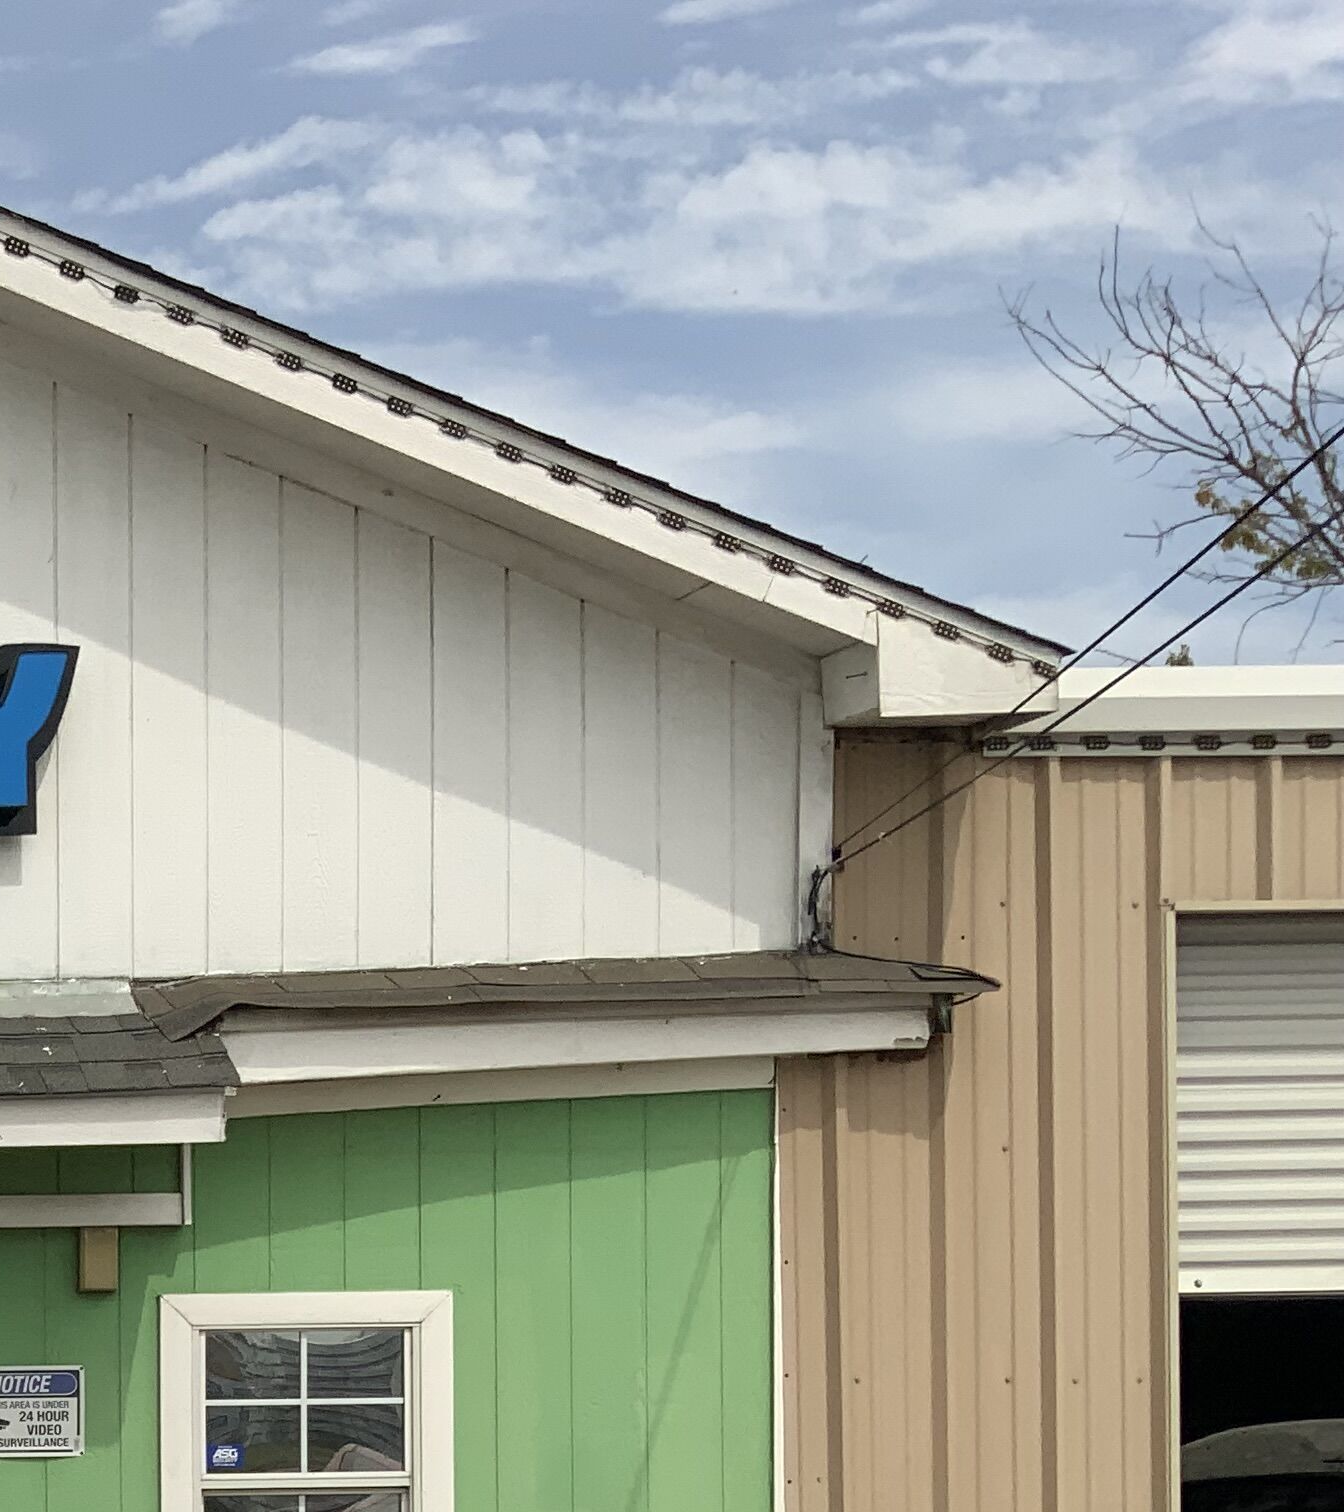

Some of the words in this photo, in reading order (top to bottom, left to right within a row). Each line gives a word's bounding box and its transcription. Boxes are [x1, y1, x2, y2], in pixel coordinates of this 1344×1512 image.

[9, 1401, 30, 1409] AREA
[32, 1401, 40, 1409] IS
[18, 1411, 33, 1422] 24
[37, 1411, 69, 1422] HOUR
[27, 1424, 62, 1436] VIDEO
